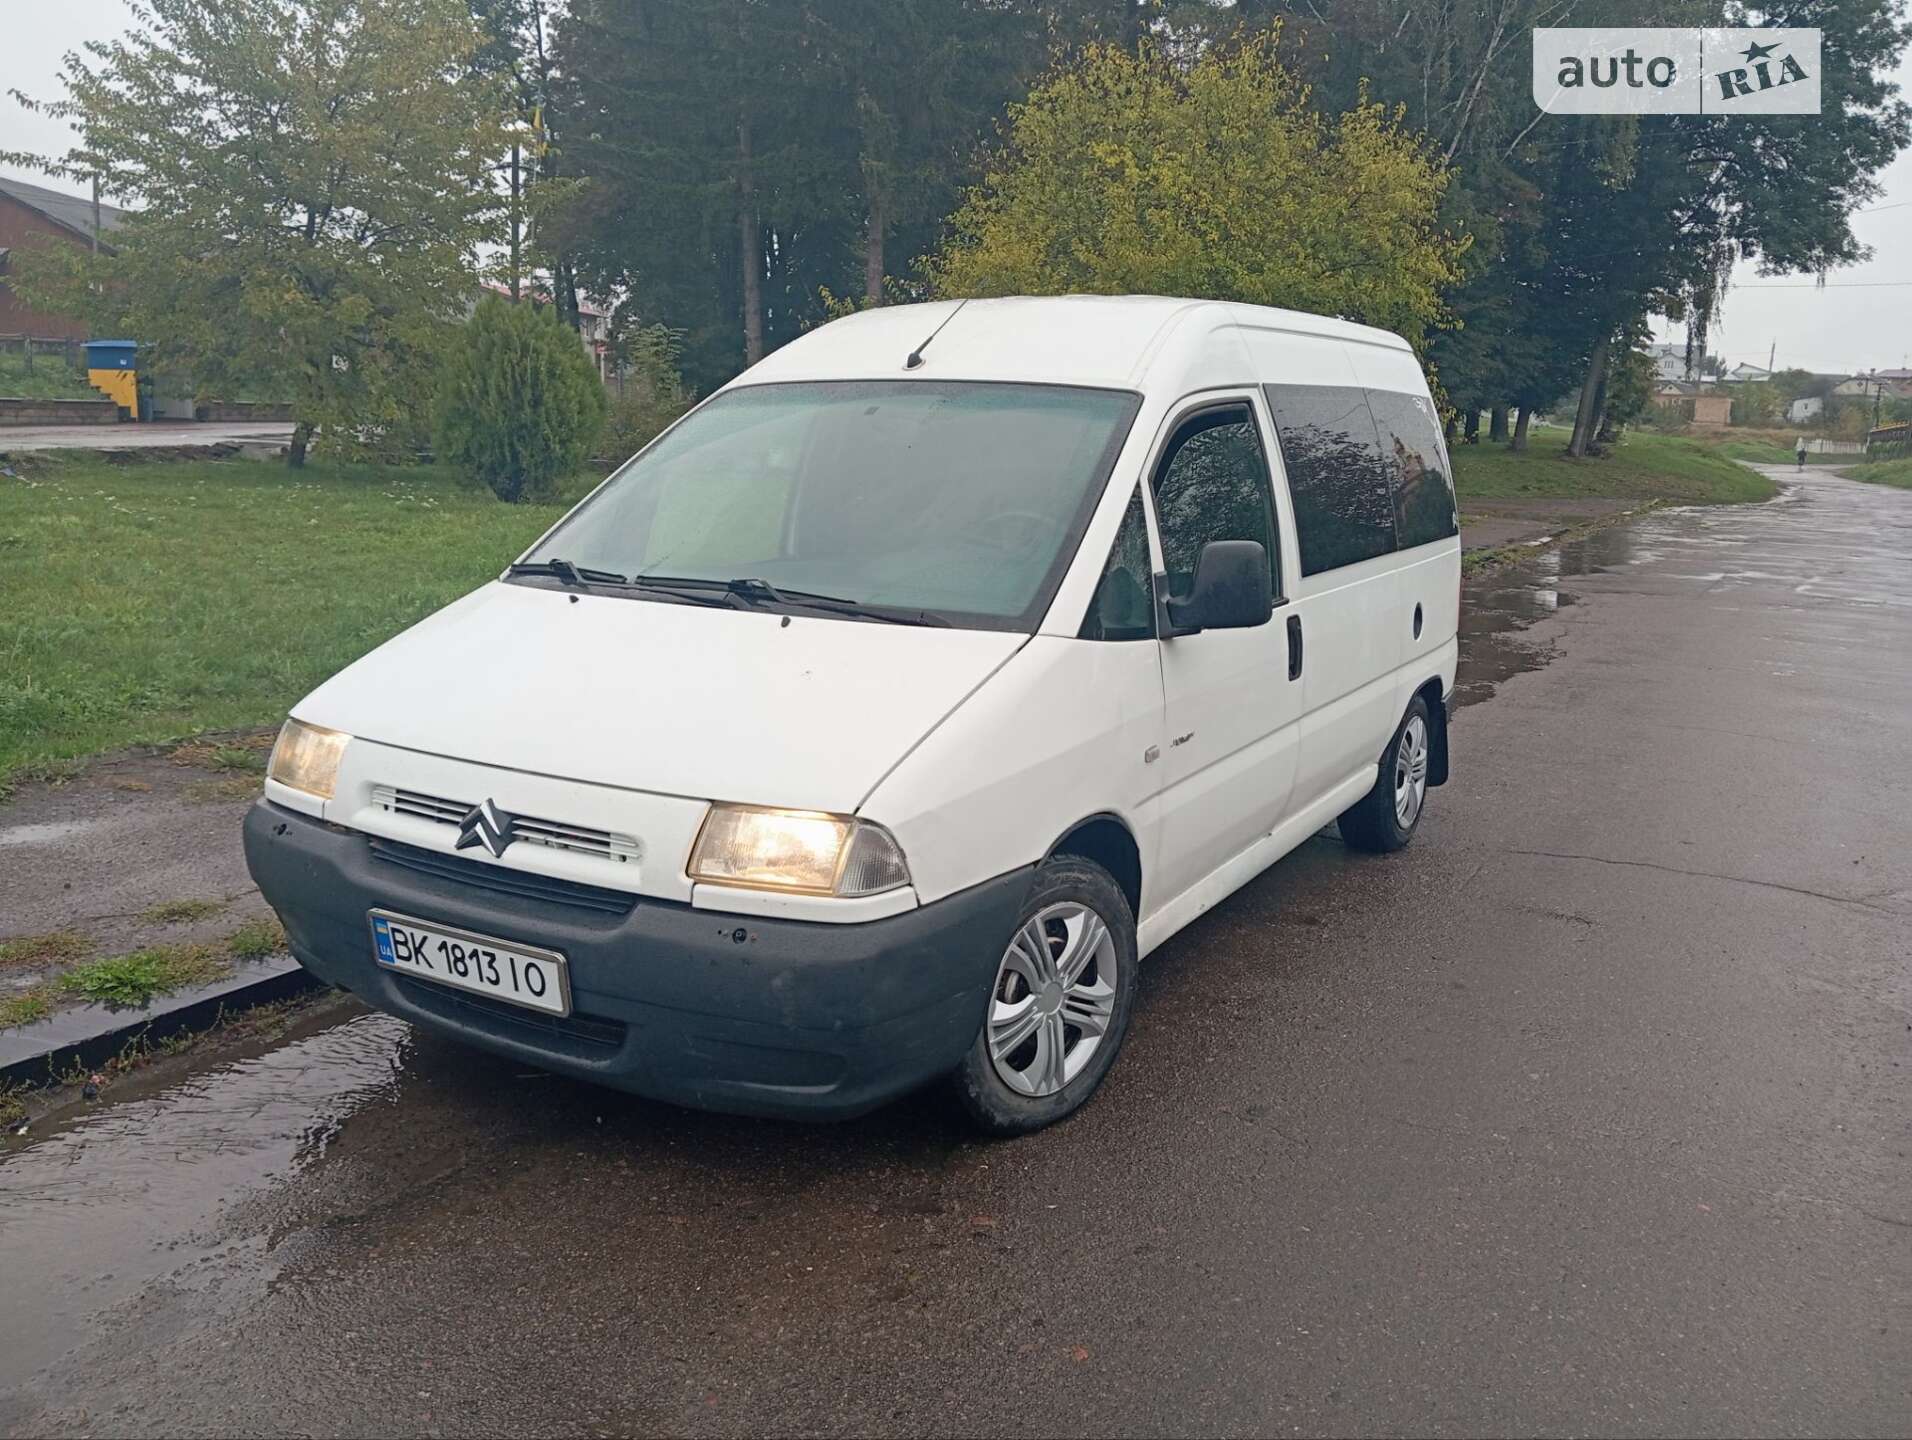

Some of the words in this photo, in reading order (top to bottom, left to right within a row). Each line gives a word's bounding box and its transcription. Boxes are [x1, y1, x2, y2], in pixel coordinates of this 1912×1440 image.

[380, 944, 393, 957] UA
[390, 927, 434, 969] BK
[437, 940, 501, 986] 1813
[509, 957, 546, 998] IO
